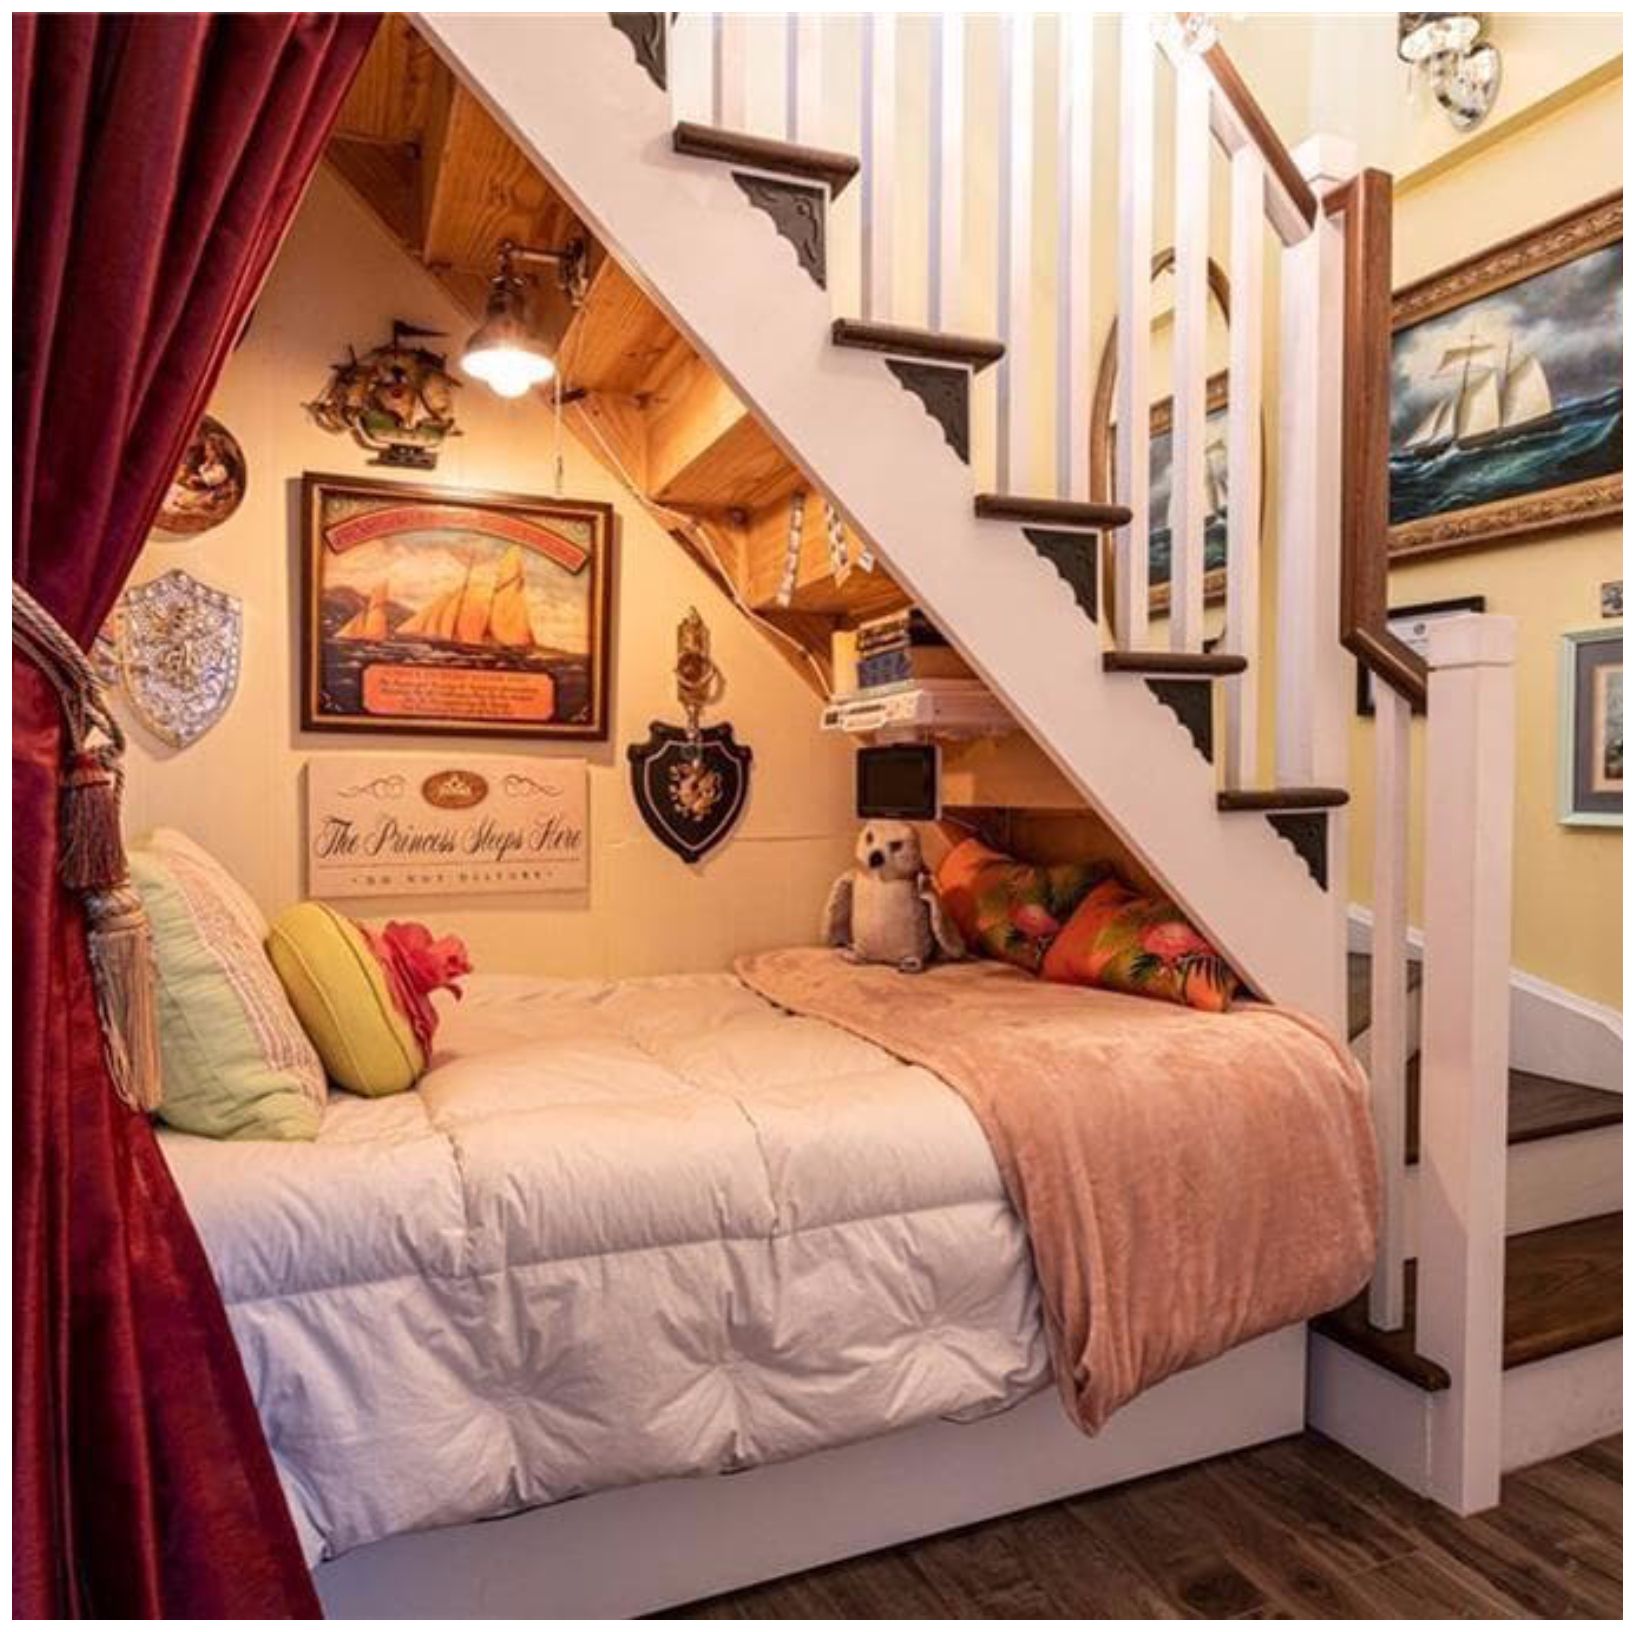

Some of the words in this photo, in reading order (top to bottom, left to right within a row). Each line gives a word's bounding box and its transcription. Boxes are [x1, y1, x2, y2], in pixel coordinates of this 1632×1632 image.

[319, 816, 358, 859] The
[365, 815, 455, 857] Princess
[464, 815, 524, 861] Sleeps
[531, 812, 583, 852] Here
